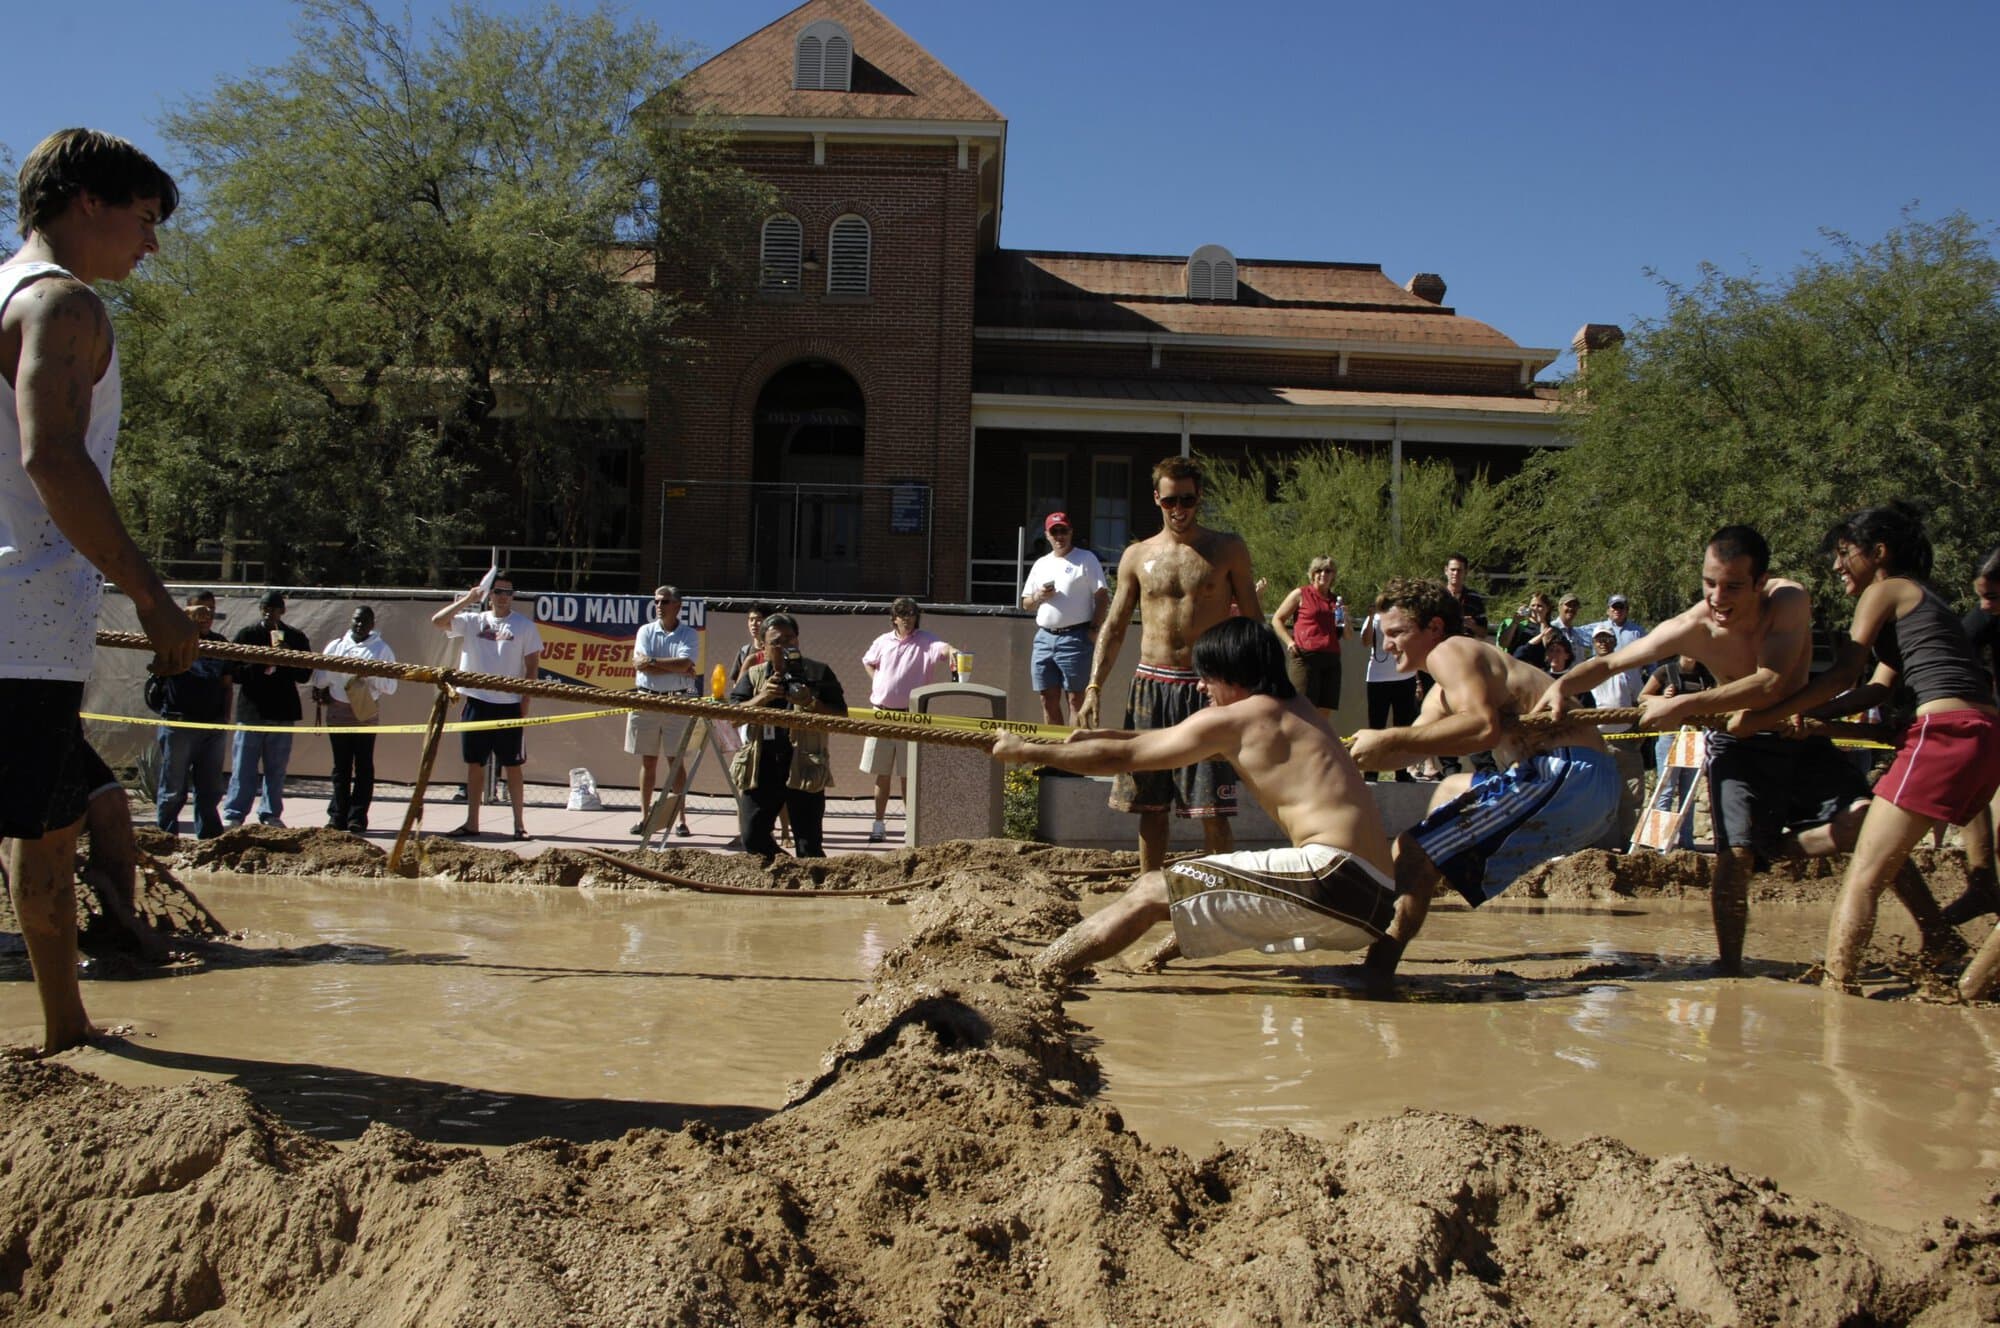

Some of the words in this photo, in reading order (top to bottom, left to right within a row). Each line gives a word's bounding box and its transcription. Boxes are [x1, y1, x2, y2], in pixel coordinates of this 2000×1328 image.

[536, 596, 578, 622] OLD
[585, 598, 639, 624] MAIN
[646, 600, 704, 626] OEN
[582, 643, 635, 662] WEST
[576, 663, 595, 679] By
[874, 710, 932, 725] CAUTION
[980, 720, 1037, 734] CAUTION
